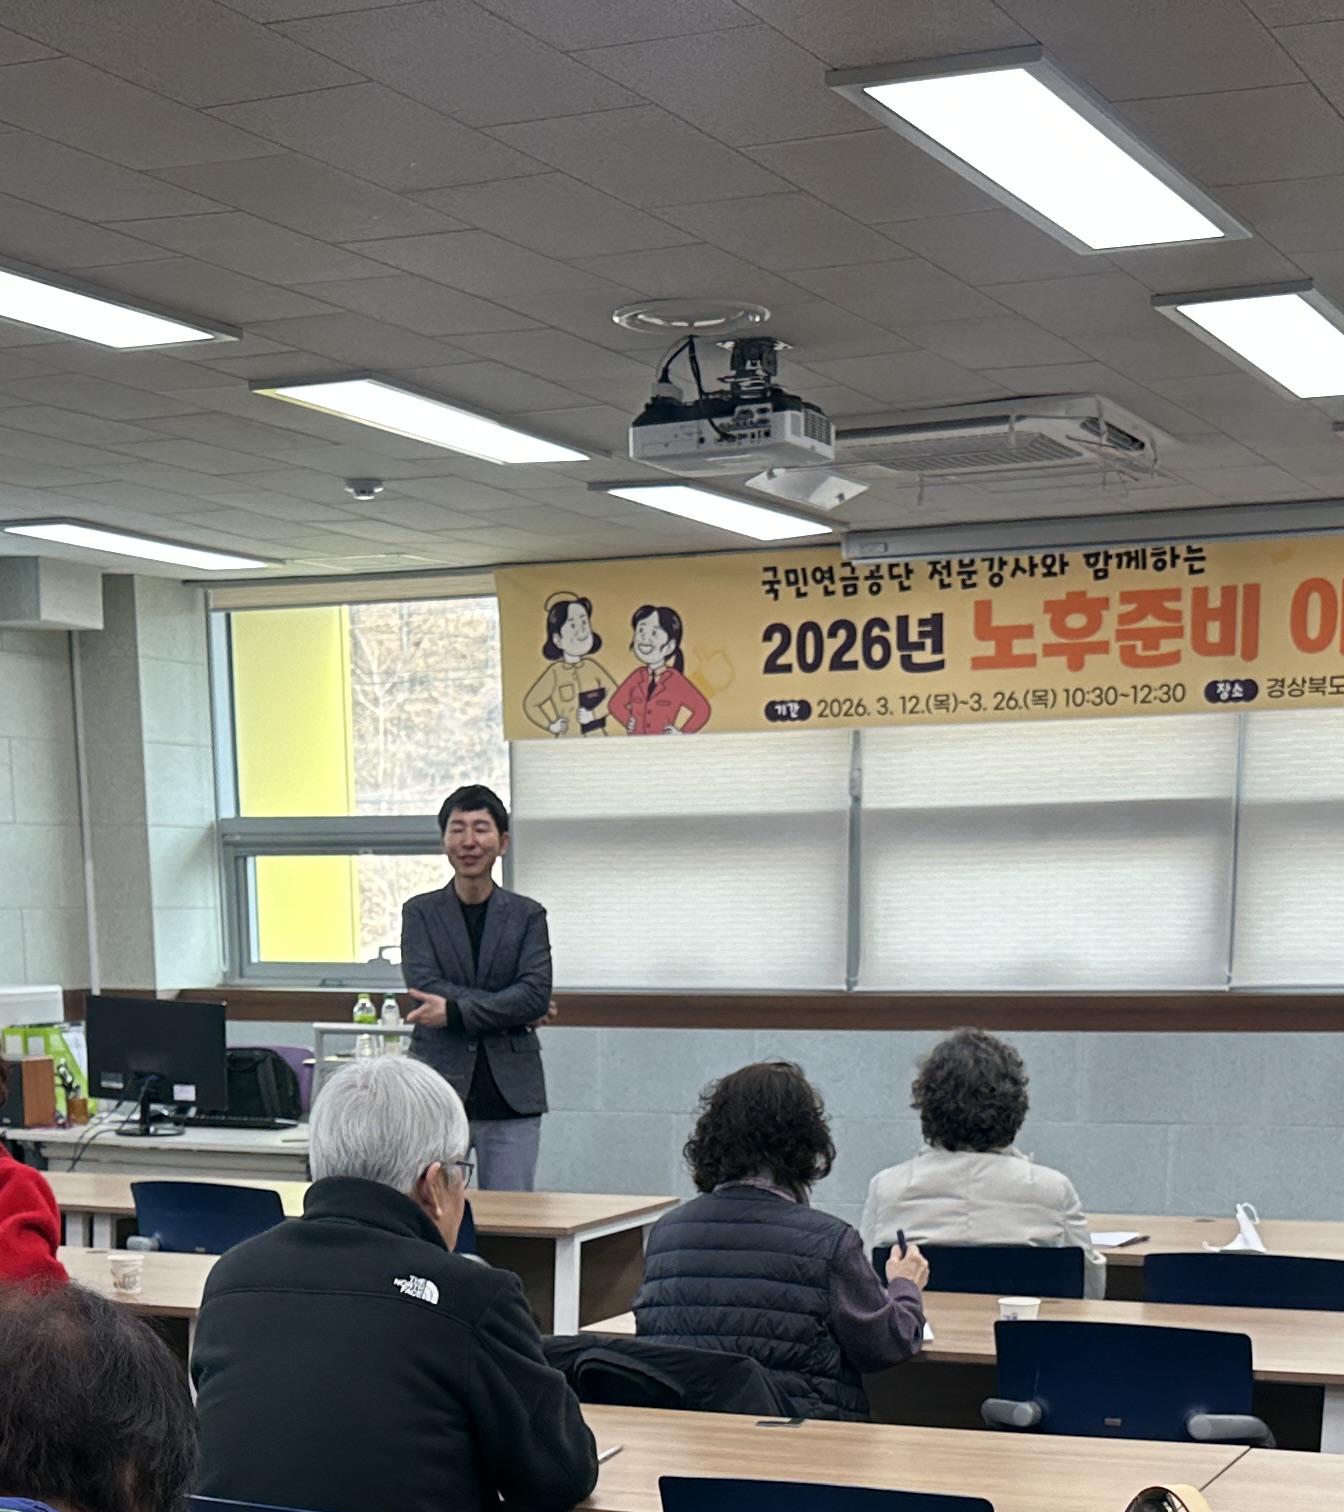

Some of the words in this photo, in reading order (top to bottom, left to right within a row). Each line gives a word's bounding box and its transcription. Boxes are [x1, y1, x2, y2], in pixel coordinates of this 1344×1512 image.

[761, 561, 914, 601] 국민연금공단
[927, 553, 1069, 590] 전문강사와
[1083, 545, 1206, 581] 함께하는
[761, 612, 946, 675] 2026년
[970, 583, 1261, 672] 노후준비
[773, 701, 801, 719] 기간
[816, 698, 871, 718] 2026.
[1063, 682, 1186, 708] 10:30~12:30
[1215, 682, 1245, 700] 장소
